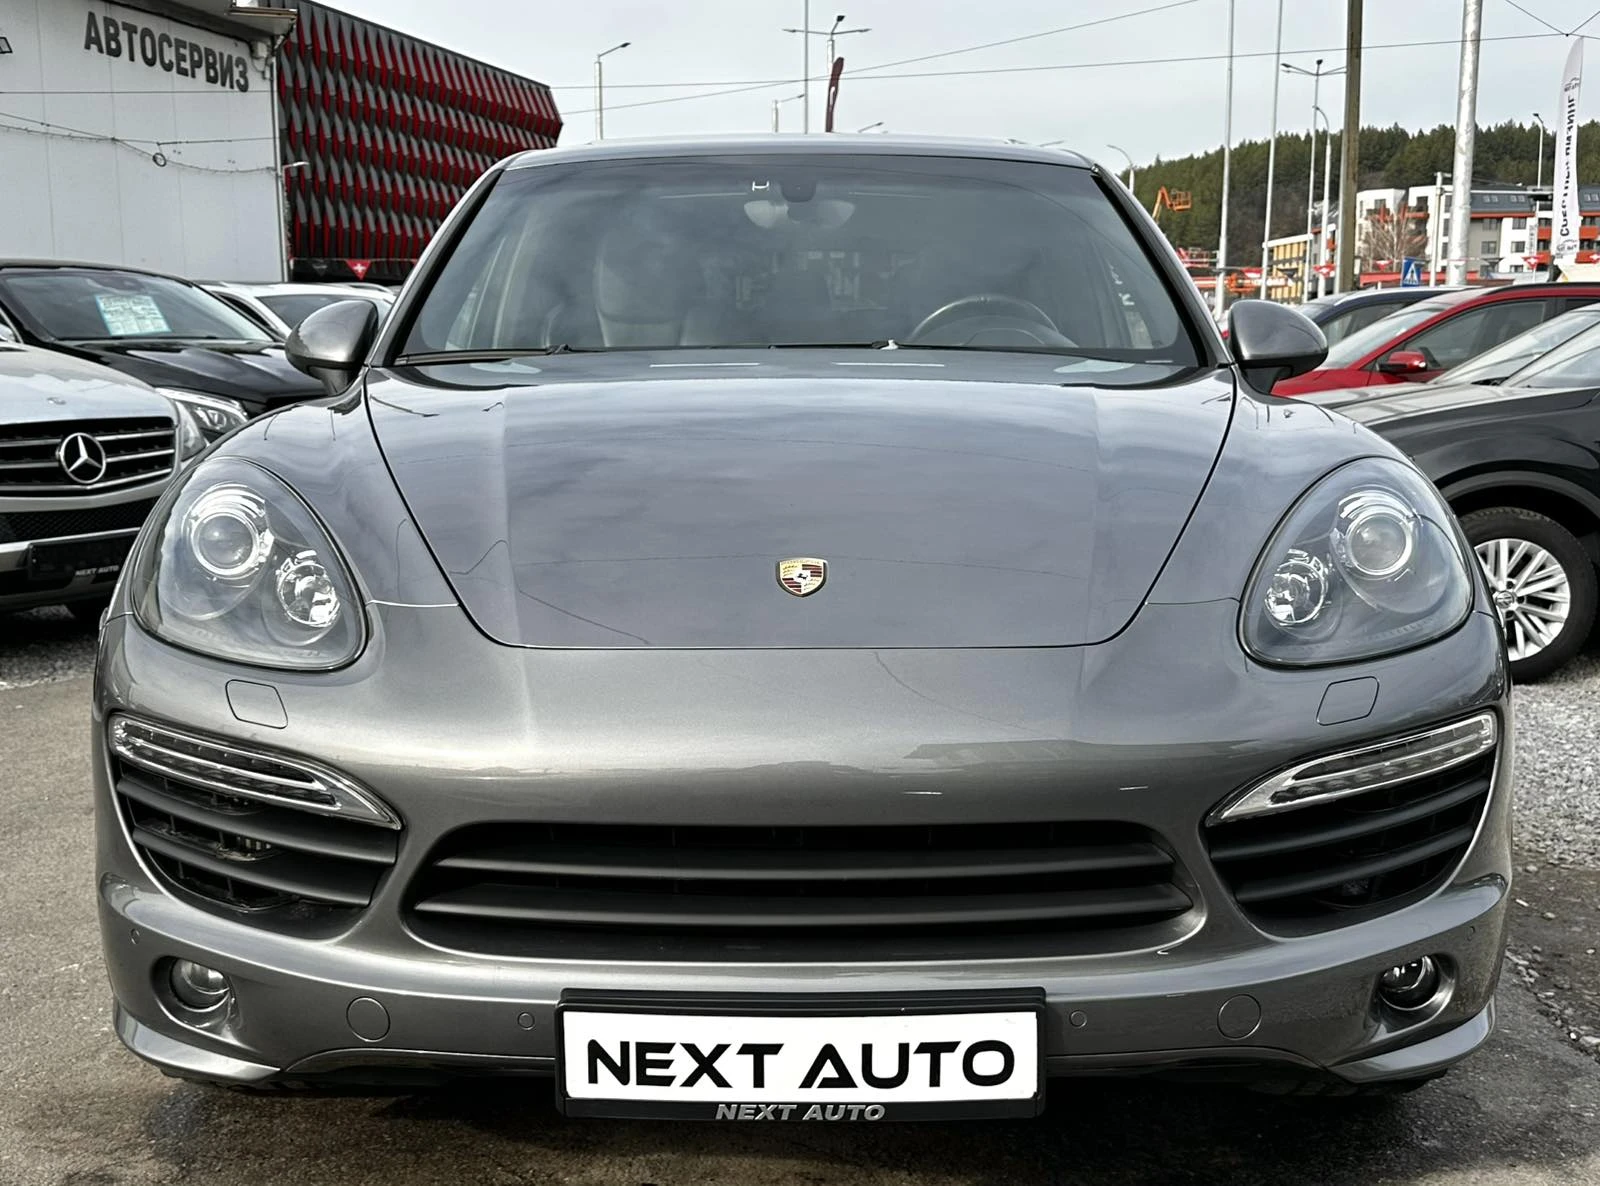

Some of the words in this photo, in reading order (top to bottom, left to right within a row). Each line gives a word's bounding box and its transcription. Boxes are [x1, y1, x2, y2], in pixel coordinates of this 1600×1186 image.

[84, 11, 249, 93] АВТОСЕРВИЗ
[588, 1039, 784, 1088] NEXT
[799, 1040, 1015, 1089] AUTO
[715, 1104, 798, 1121] NEXT
[802, 1104, 886, 1121] AUTO
